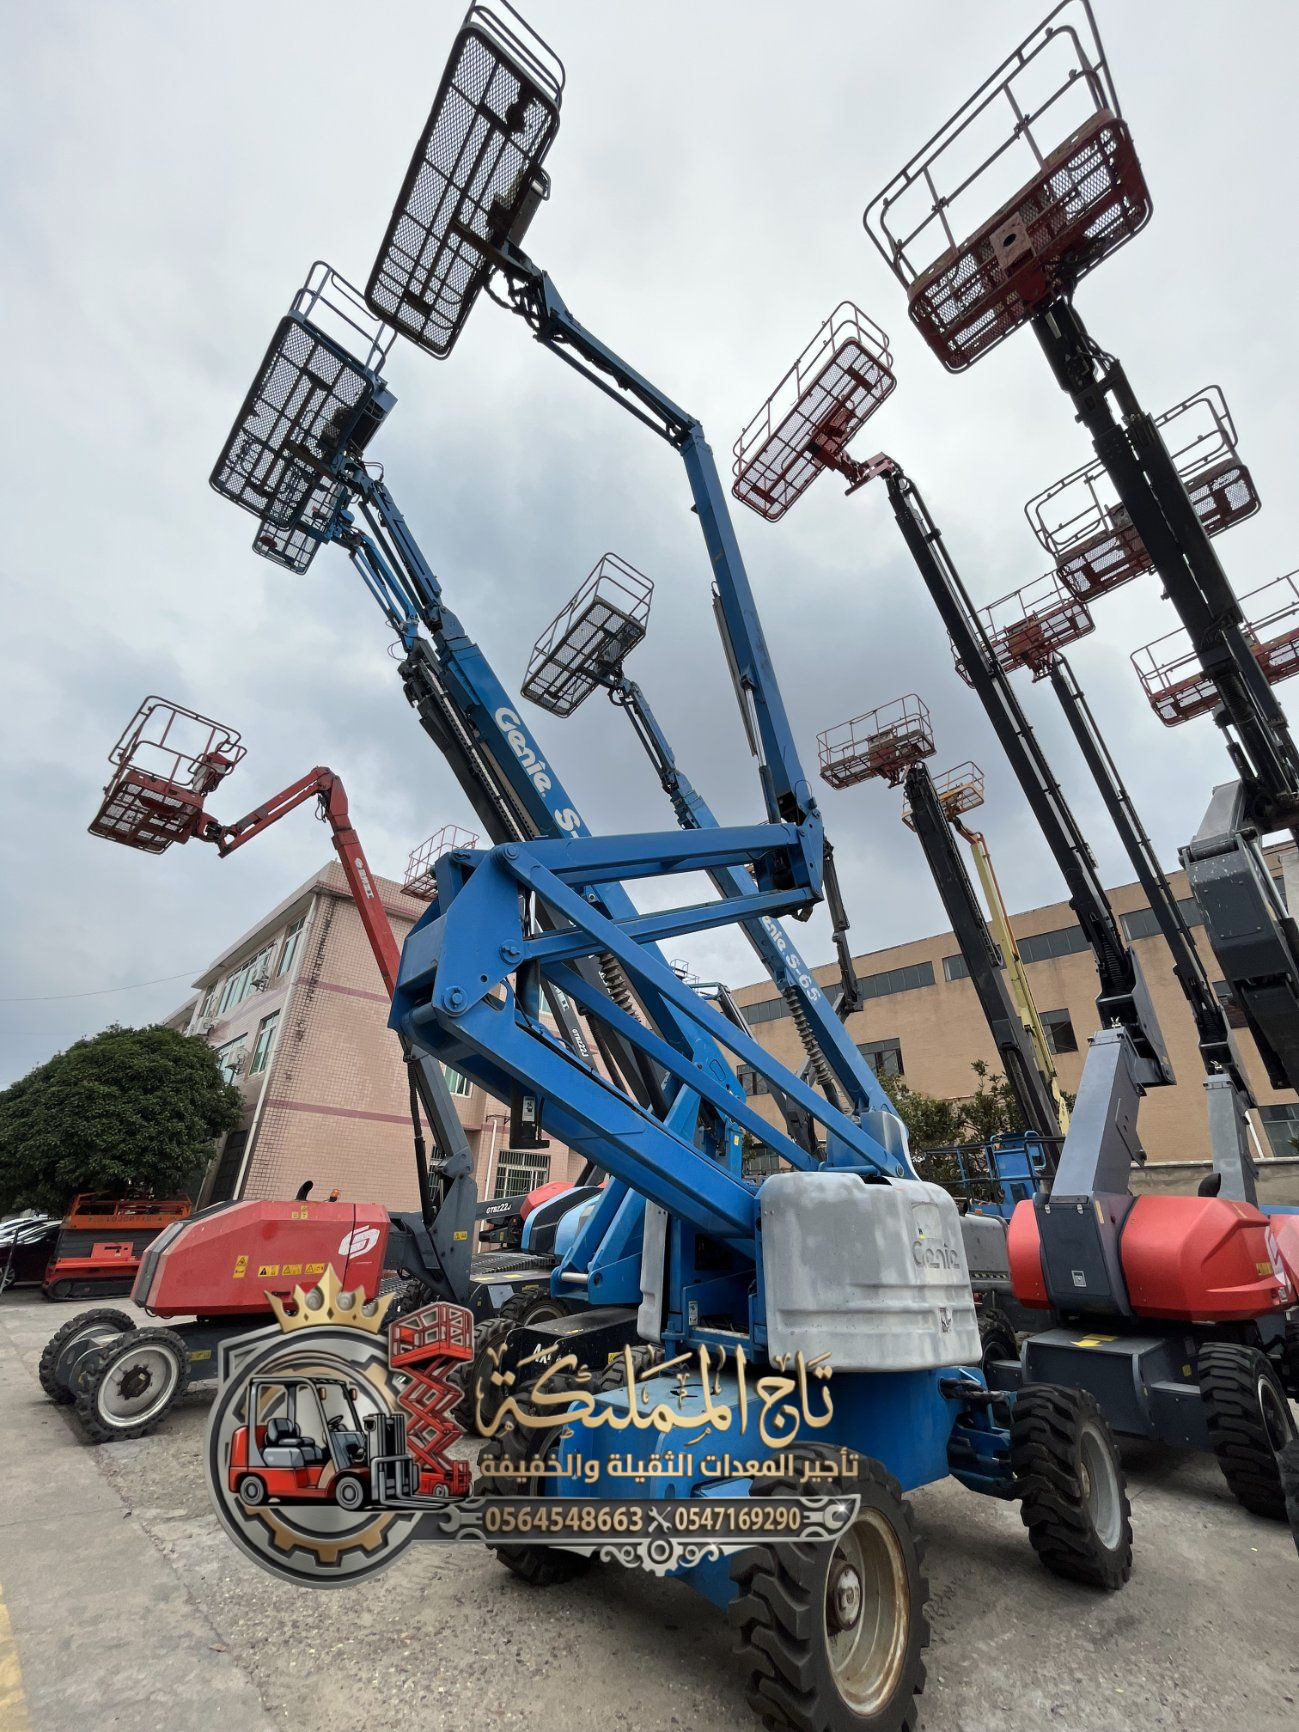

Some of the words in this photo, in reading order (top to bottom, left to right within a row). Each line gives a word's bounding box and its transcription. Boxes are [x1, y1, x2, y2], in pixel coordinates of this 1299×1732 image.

[495, 707, 552, 796] Genie
[761, 916, 786, 953] enie
[785, 954, 821, 1001] S-65
[912, 1241, 960, 1269] Genie
